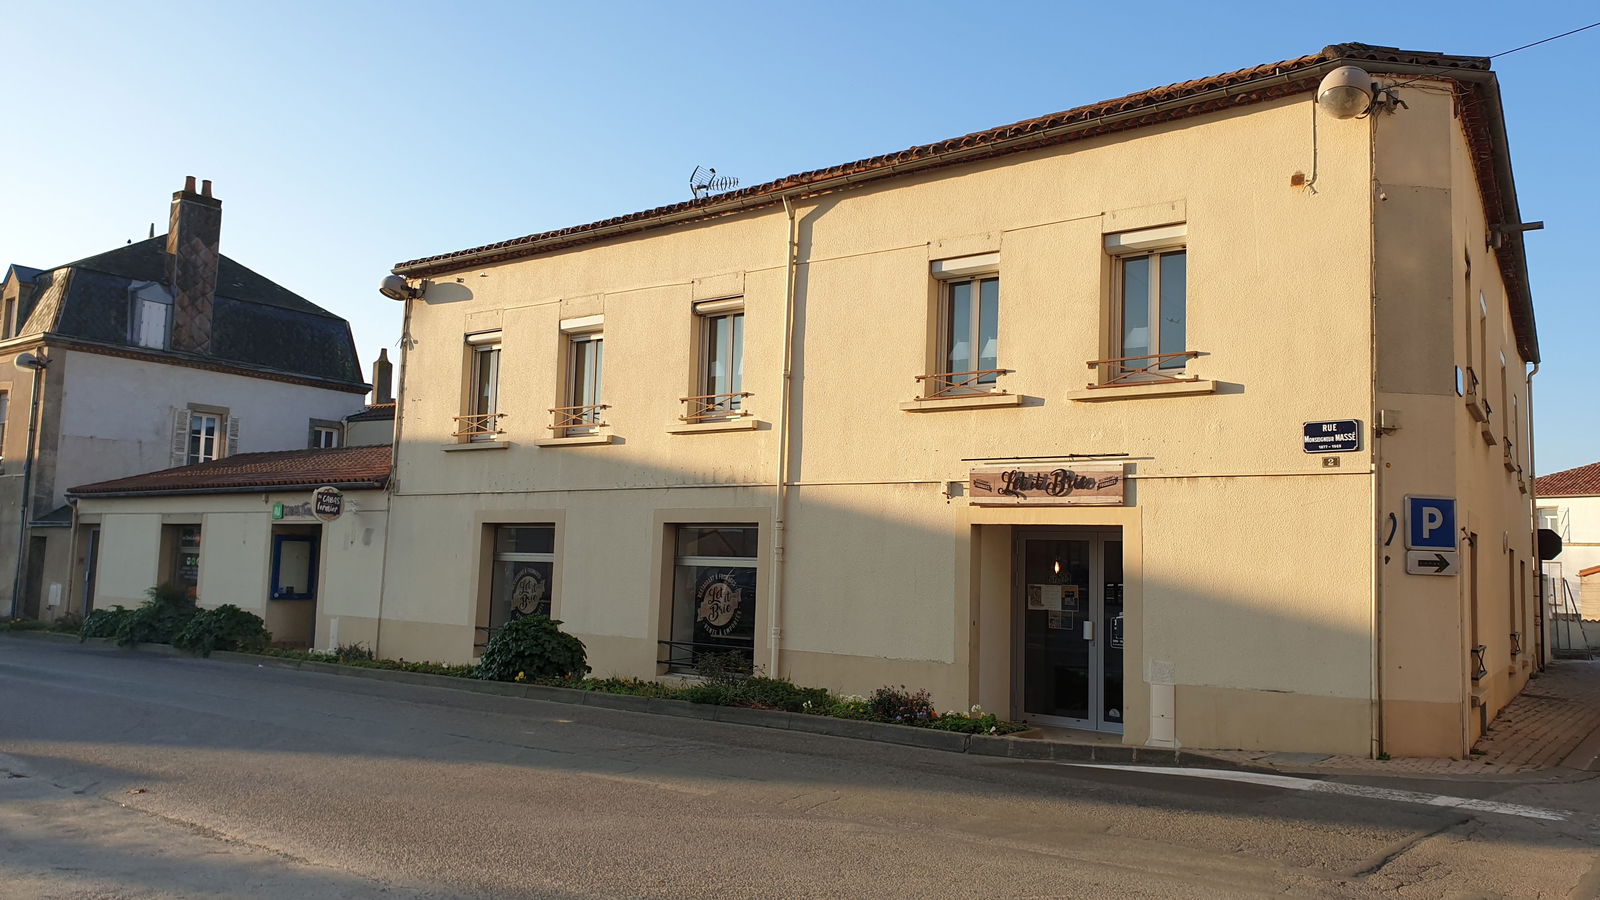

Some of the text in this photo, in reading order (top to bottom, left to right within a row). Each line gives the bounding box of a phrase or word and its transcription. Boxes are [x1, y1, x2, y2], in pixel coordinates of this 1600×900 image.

[1322, 424, 1337, 432] RUE
[1335, 432, 1355, 441] MASSÉ
[1328, 458, 1334, 466] 2
[1046, 468, 1096, 497] Brie
[323, 495, 340, 504] CABAS
[1422, 506, 1443, 538] P
[708, 586, 723, 604] Let
[708, 603, 731, 621] Brie
